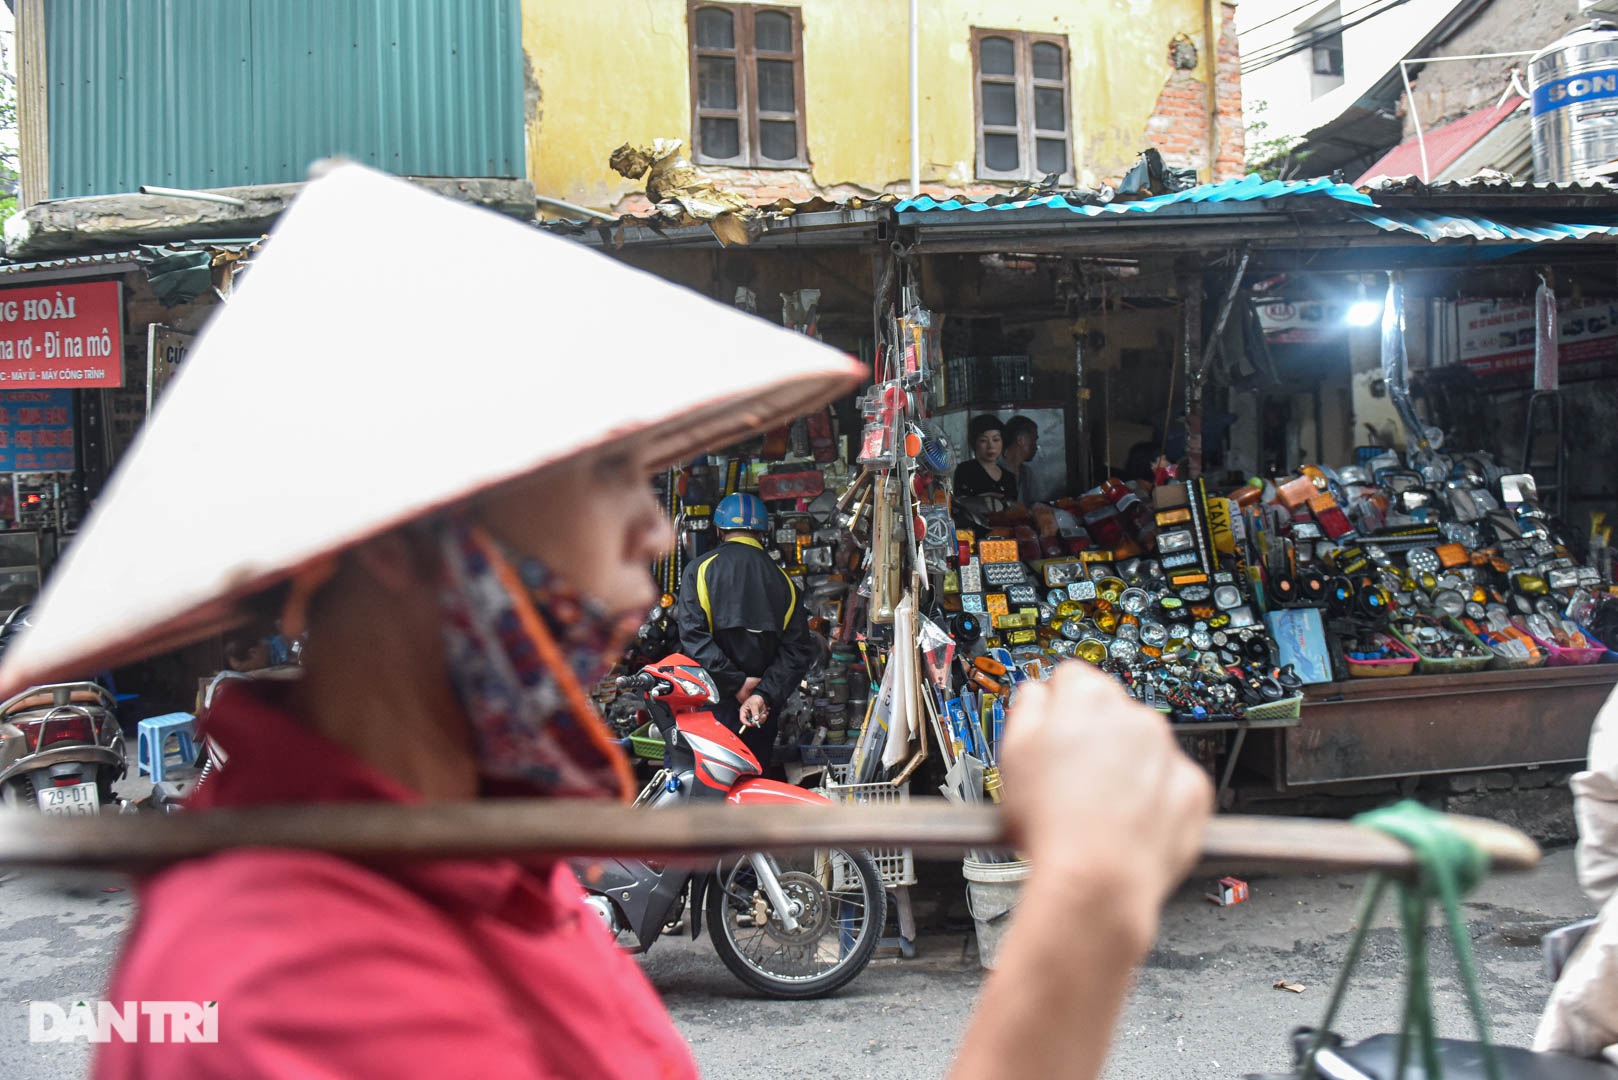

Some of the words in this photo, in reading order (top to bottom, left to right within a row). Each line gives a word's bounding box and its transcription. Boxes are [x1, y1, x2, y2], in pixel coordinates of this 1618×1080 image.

[0, 301, 18, 322] G
[23, 291, 76, 320] HOÀI
[44, 331, 60, 358] Đi
[64, 336, 82, 358] na
[86, 327, 111, 357] mô
[59, 368, 83, 380] CÔNG
[84, 366, 105, 379] TRÌNH
[1206, 502, 1229, 535] TAXI
[48, 786, 87, 806] 29-01
